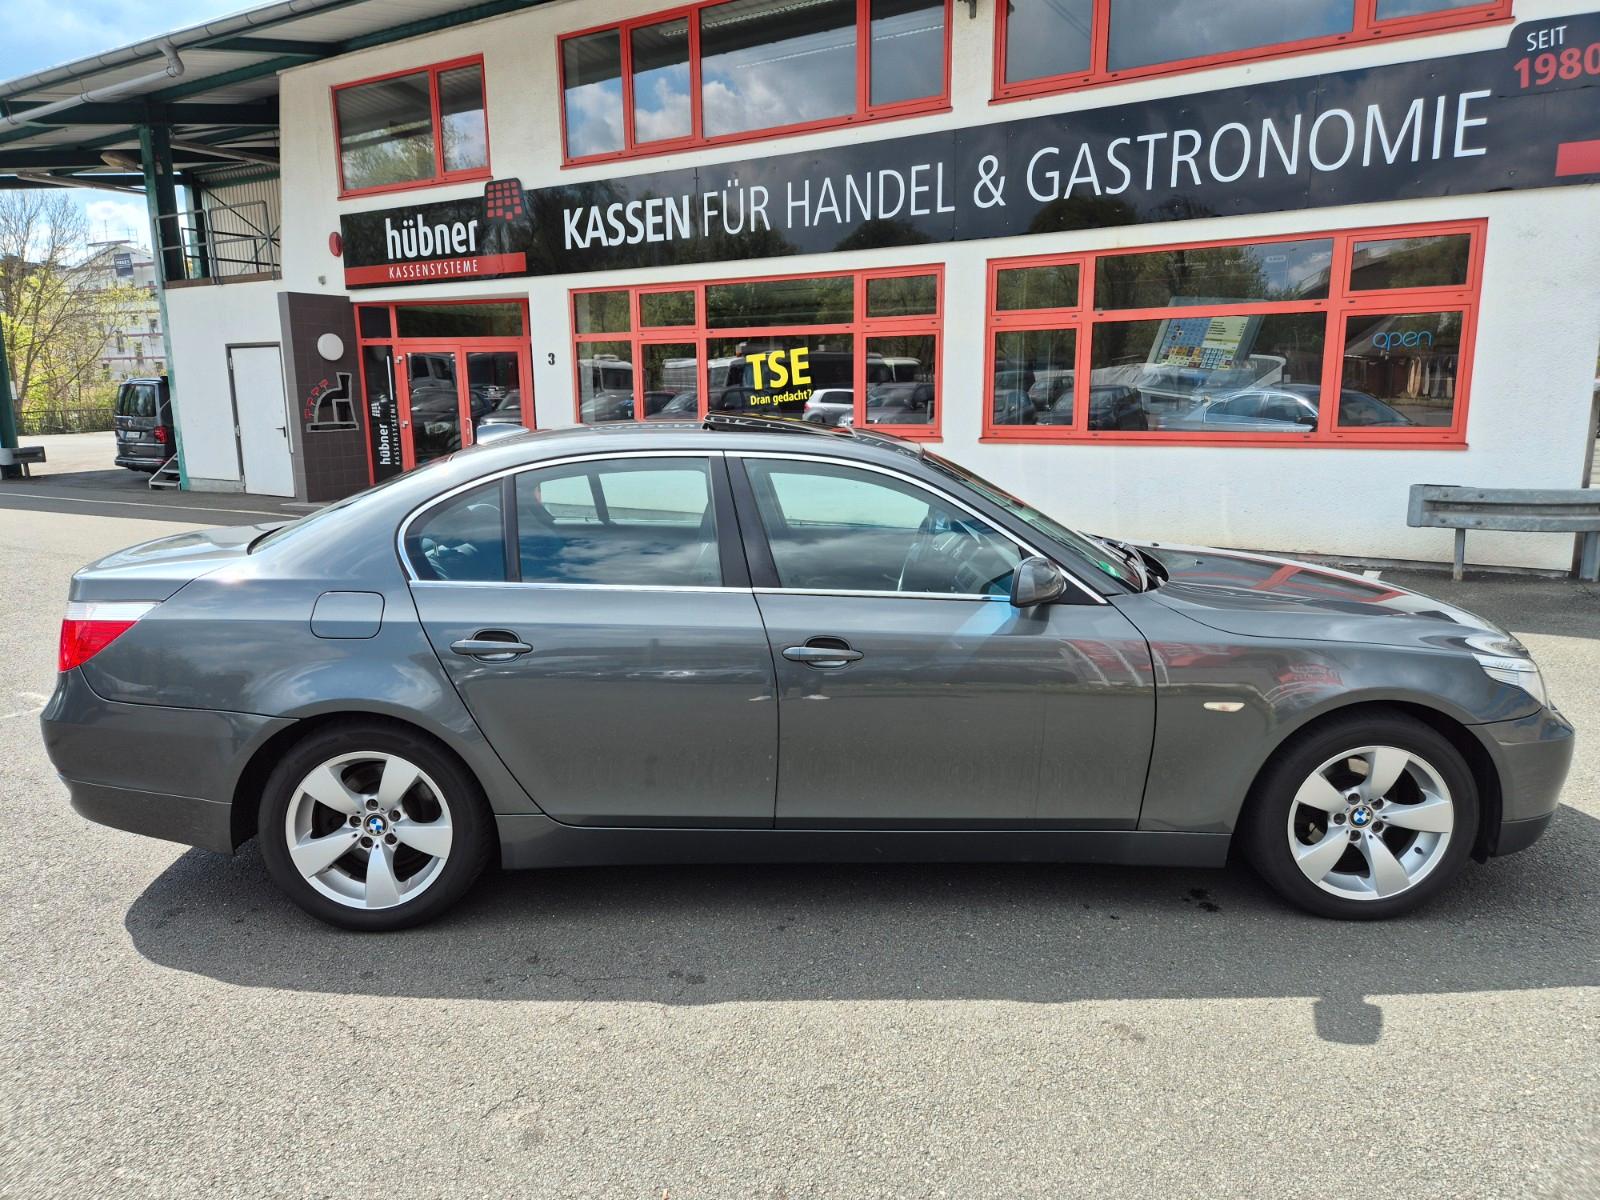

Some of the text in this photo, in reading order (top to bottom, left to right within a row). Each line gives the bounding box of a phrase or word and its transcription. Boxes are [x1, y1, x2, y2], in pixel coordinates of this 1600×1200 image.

[1526, 26, 1567, 52] SEIT
[1514, 42, 1600, 89] 1980
[563, 90, 1491, 250] KASSEN FÜR HANDEL & GASTRONOMIE
[385, 214, 478, 259] hübner
[388, 259, 479, 279] KASSENSYSTEME
[1372, 330, 1432, 352] open
[548, 353, 555, 366] 3
[746, 347, 811, 391] TSE
[750, 389, 812, 406] Dran gedacht?
[378, 424, 391, 465] hübner
